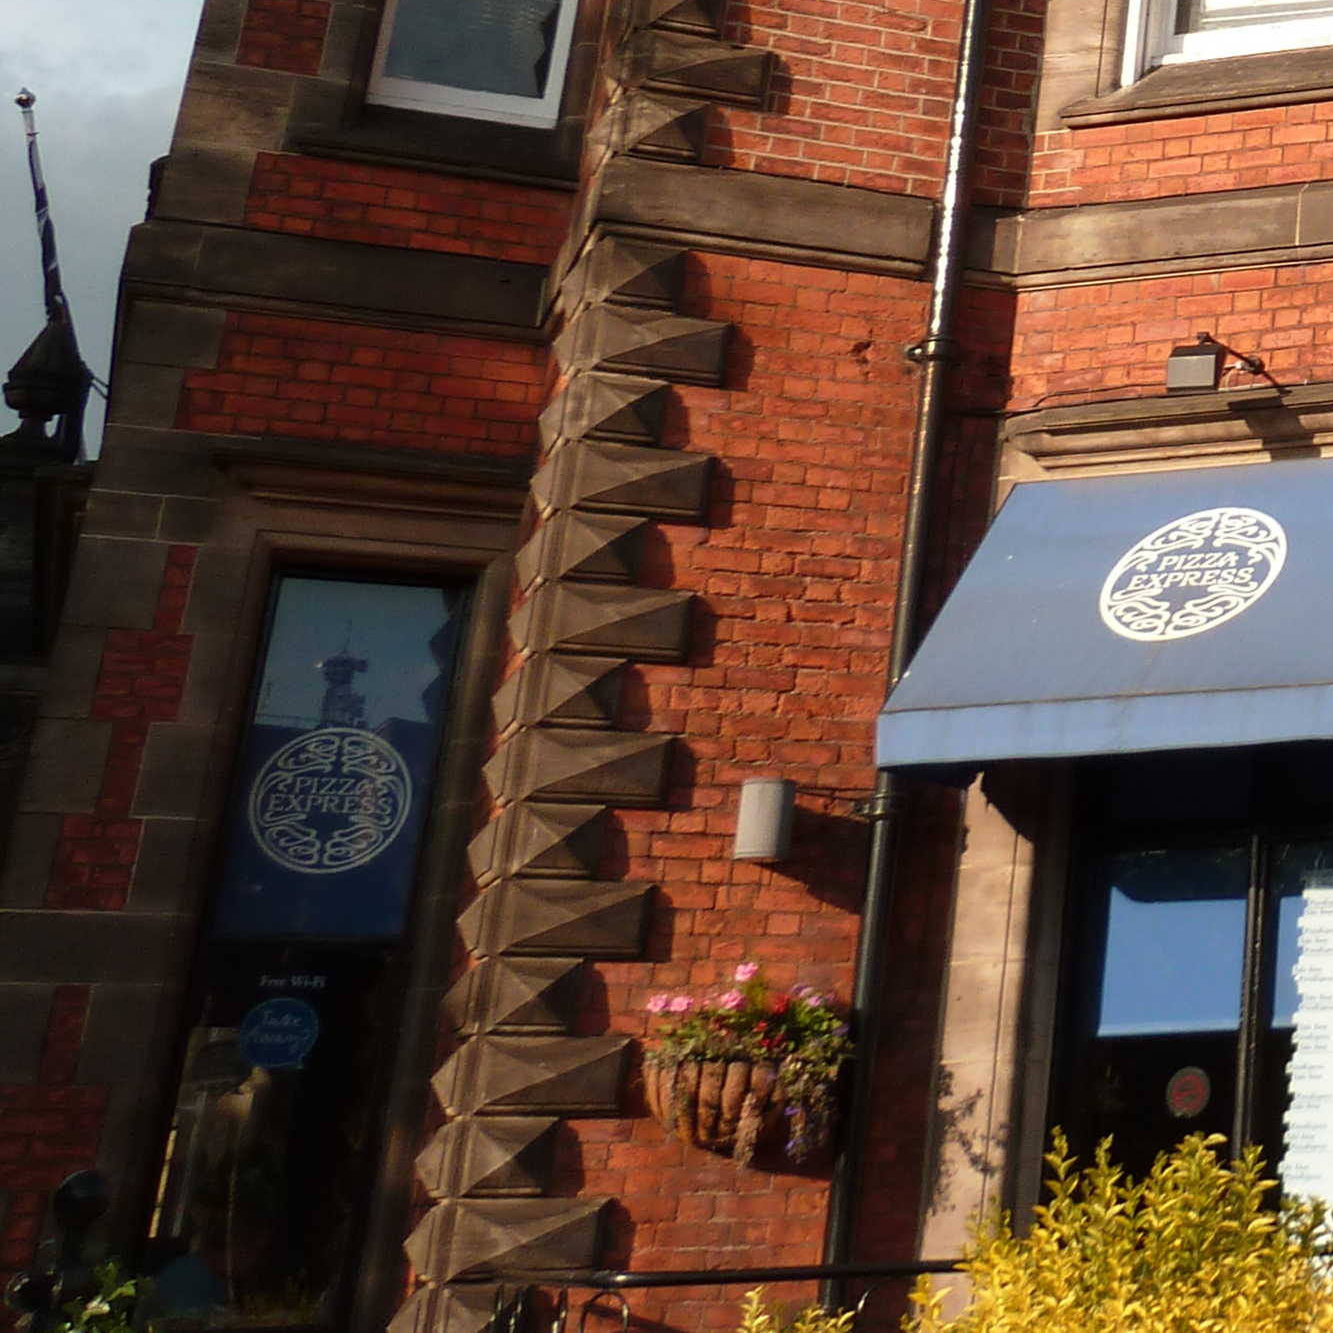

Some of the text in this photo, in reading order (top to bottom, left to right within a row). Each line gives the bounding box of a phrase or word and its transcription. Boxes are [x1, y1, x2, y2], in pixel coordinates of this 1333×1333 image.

[1156, 551, 1239, 572] PIZZA
[1126, 566, 1255, 592] EXPRESS
[292, 775, 375, 797] PIZZA
[267, 792, 393, 816] EXPRESS
